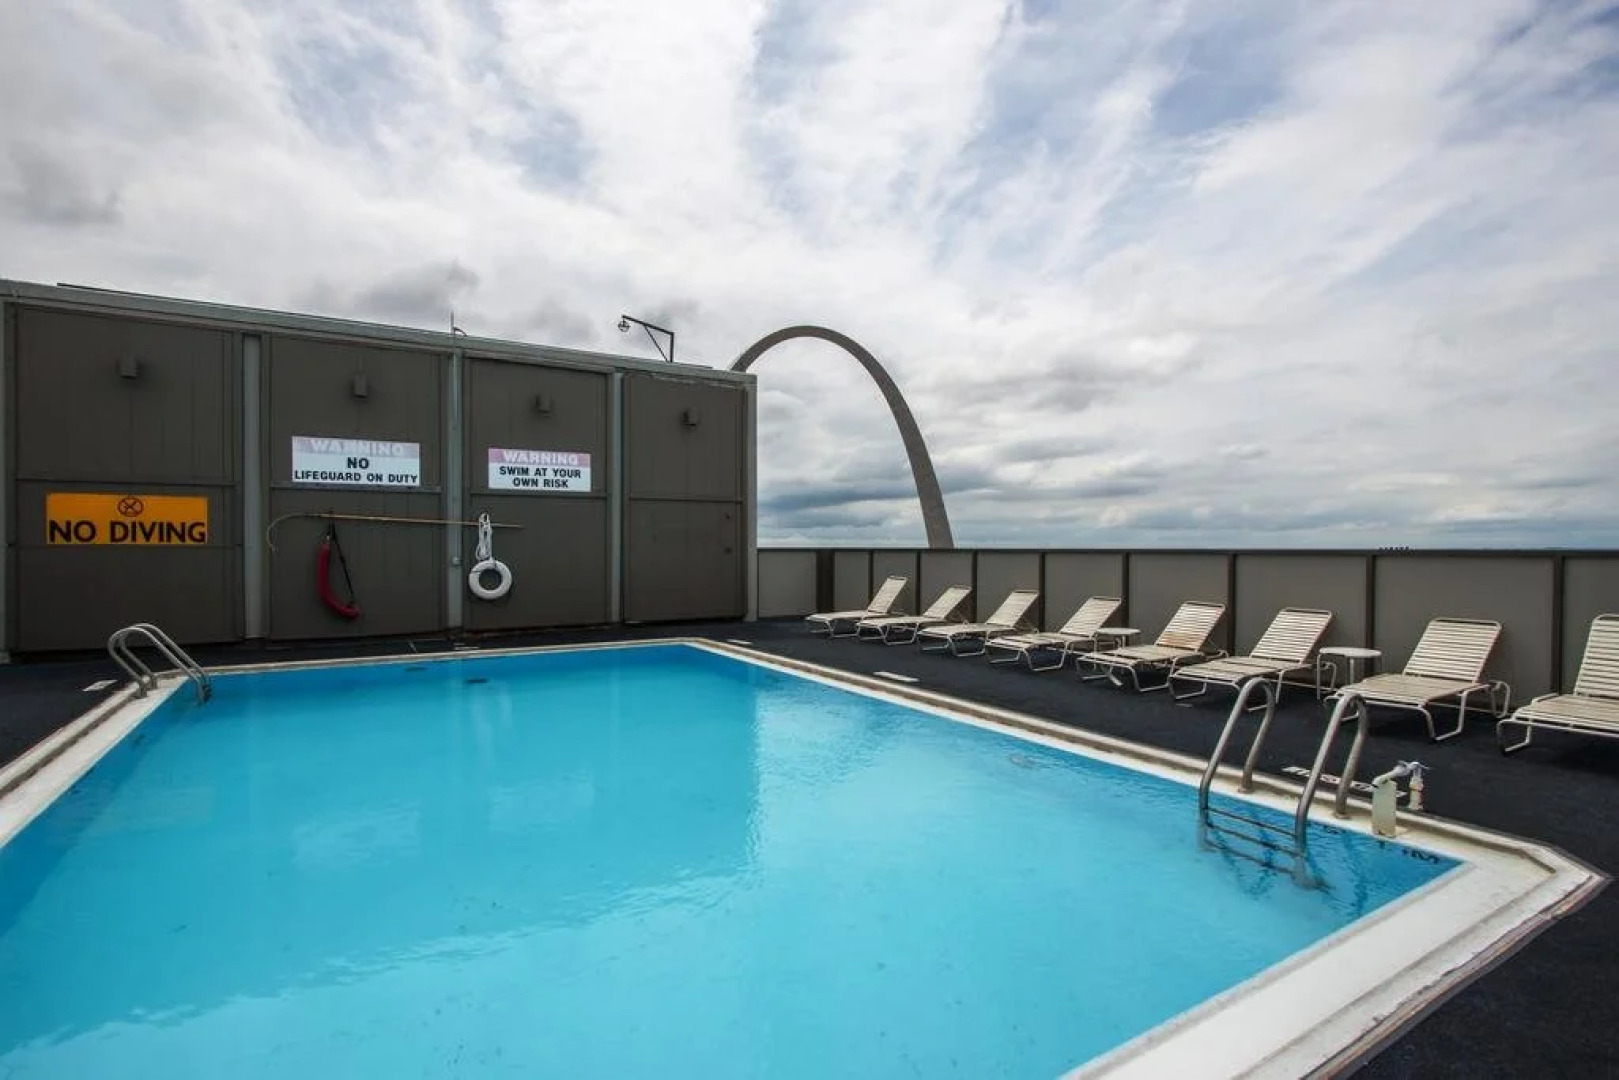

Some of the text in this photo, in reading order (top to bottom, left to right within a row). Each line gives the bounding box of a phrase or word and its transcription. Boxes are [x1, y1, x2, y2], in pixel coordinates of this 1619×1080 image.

[347, 457, 370, 469] NO
[503, 450, 578, 466] WARNING
[294, 470, 418, 483] LIFEGUARD ON DUTY
[499, 466, 581, 478] SWIM AT YOUR
[513, 478, 569, 488] OWN RISK
[49, 520, 206, 543] NO DIVING
